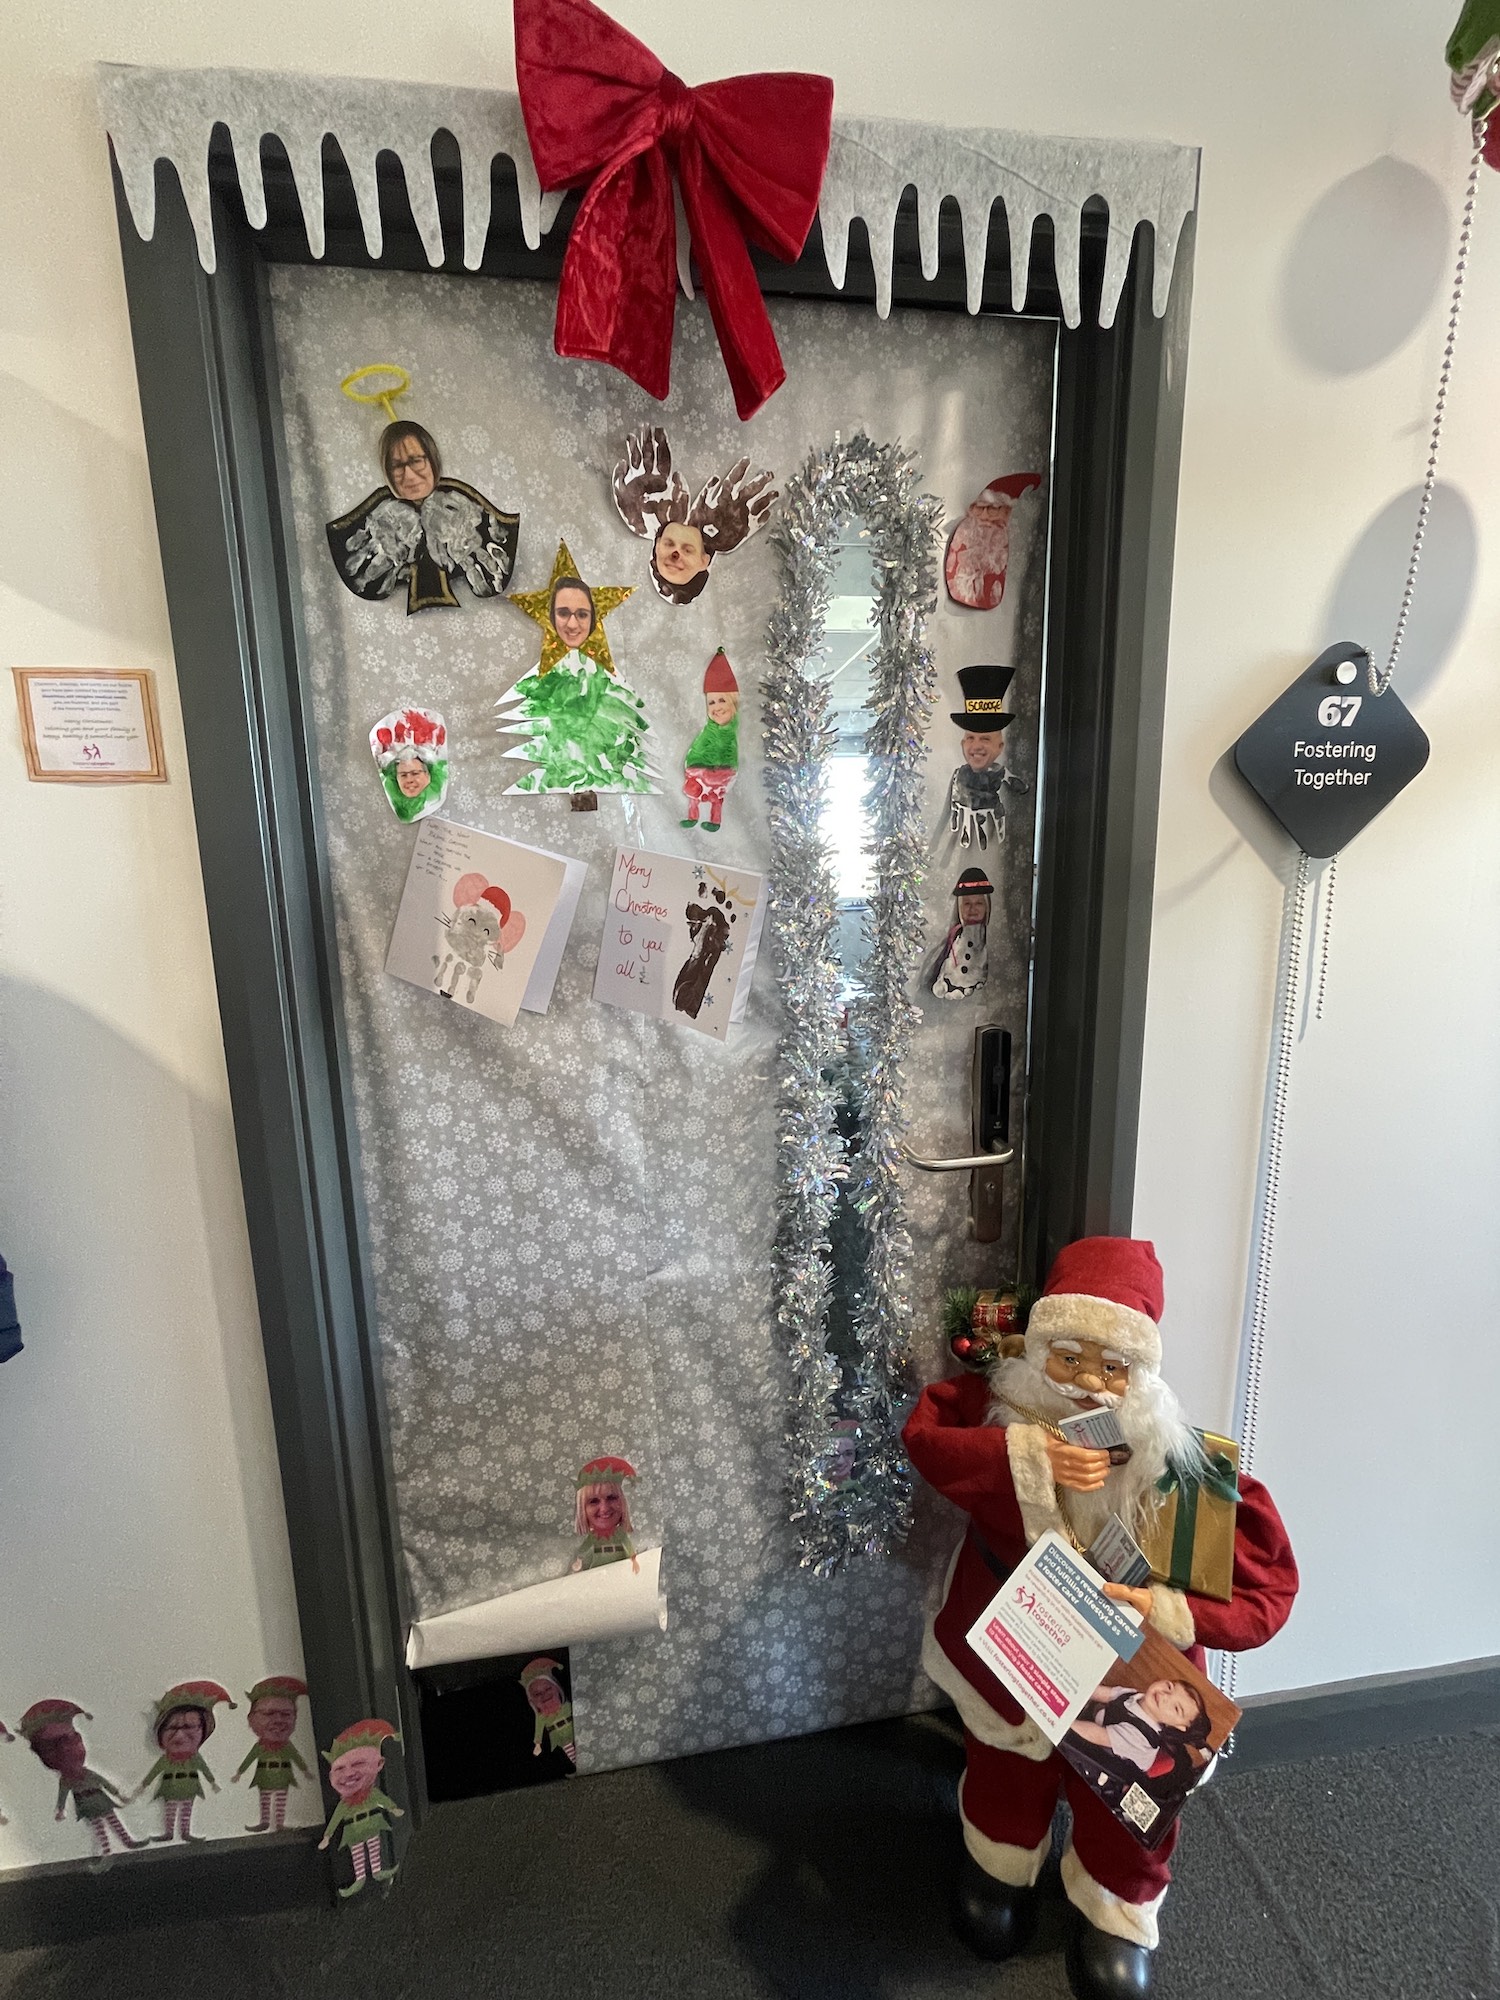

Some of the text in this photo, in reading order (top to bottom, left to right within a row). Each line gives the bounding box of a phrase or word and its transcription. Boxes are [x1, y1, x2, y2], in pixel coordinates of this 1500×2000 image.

[1317, 695, 1362, 727] 67
[1293, 740, 1376, 762] Fostering
[1294, 768, 1372, 790] Together
[619, 853, 652, 889] Merry
[615, 888, 668, 921] Christmas
[618, 925, 664, 963] to you
[616, 960, 635, 979] all
[1041, 1564, 1063, 1587] foster
[1060, 1584, 1079, 1605] carer
[1042, 1553, 1121, 1636] and fulfilling lifestyle as
[1047, 1545, 1076, 1576] Discover
[1078, 1578, 1115, 1617] rewarding
[1113, 1613, 1138, 1639] career
[991, 1620, 1007, 1638] Learn
[1029, 1607, 1067, 1649] together
[1034, 1601, 1073, 1644] fostering
[1003, 1635, 1020, 1654] about
[1016, 1651, 1031, 1668] your
[1028, 1663, 1035, 1671] 3
[1031, 1667, 1052, 1691] simple
[1048, 1687, 1066, 1708] steps
